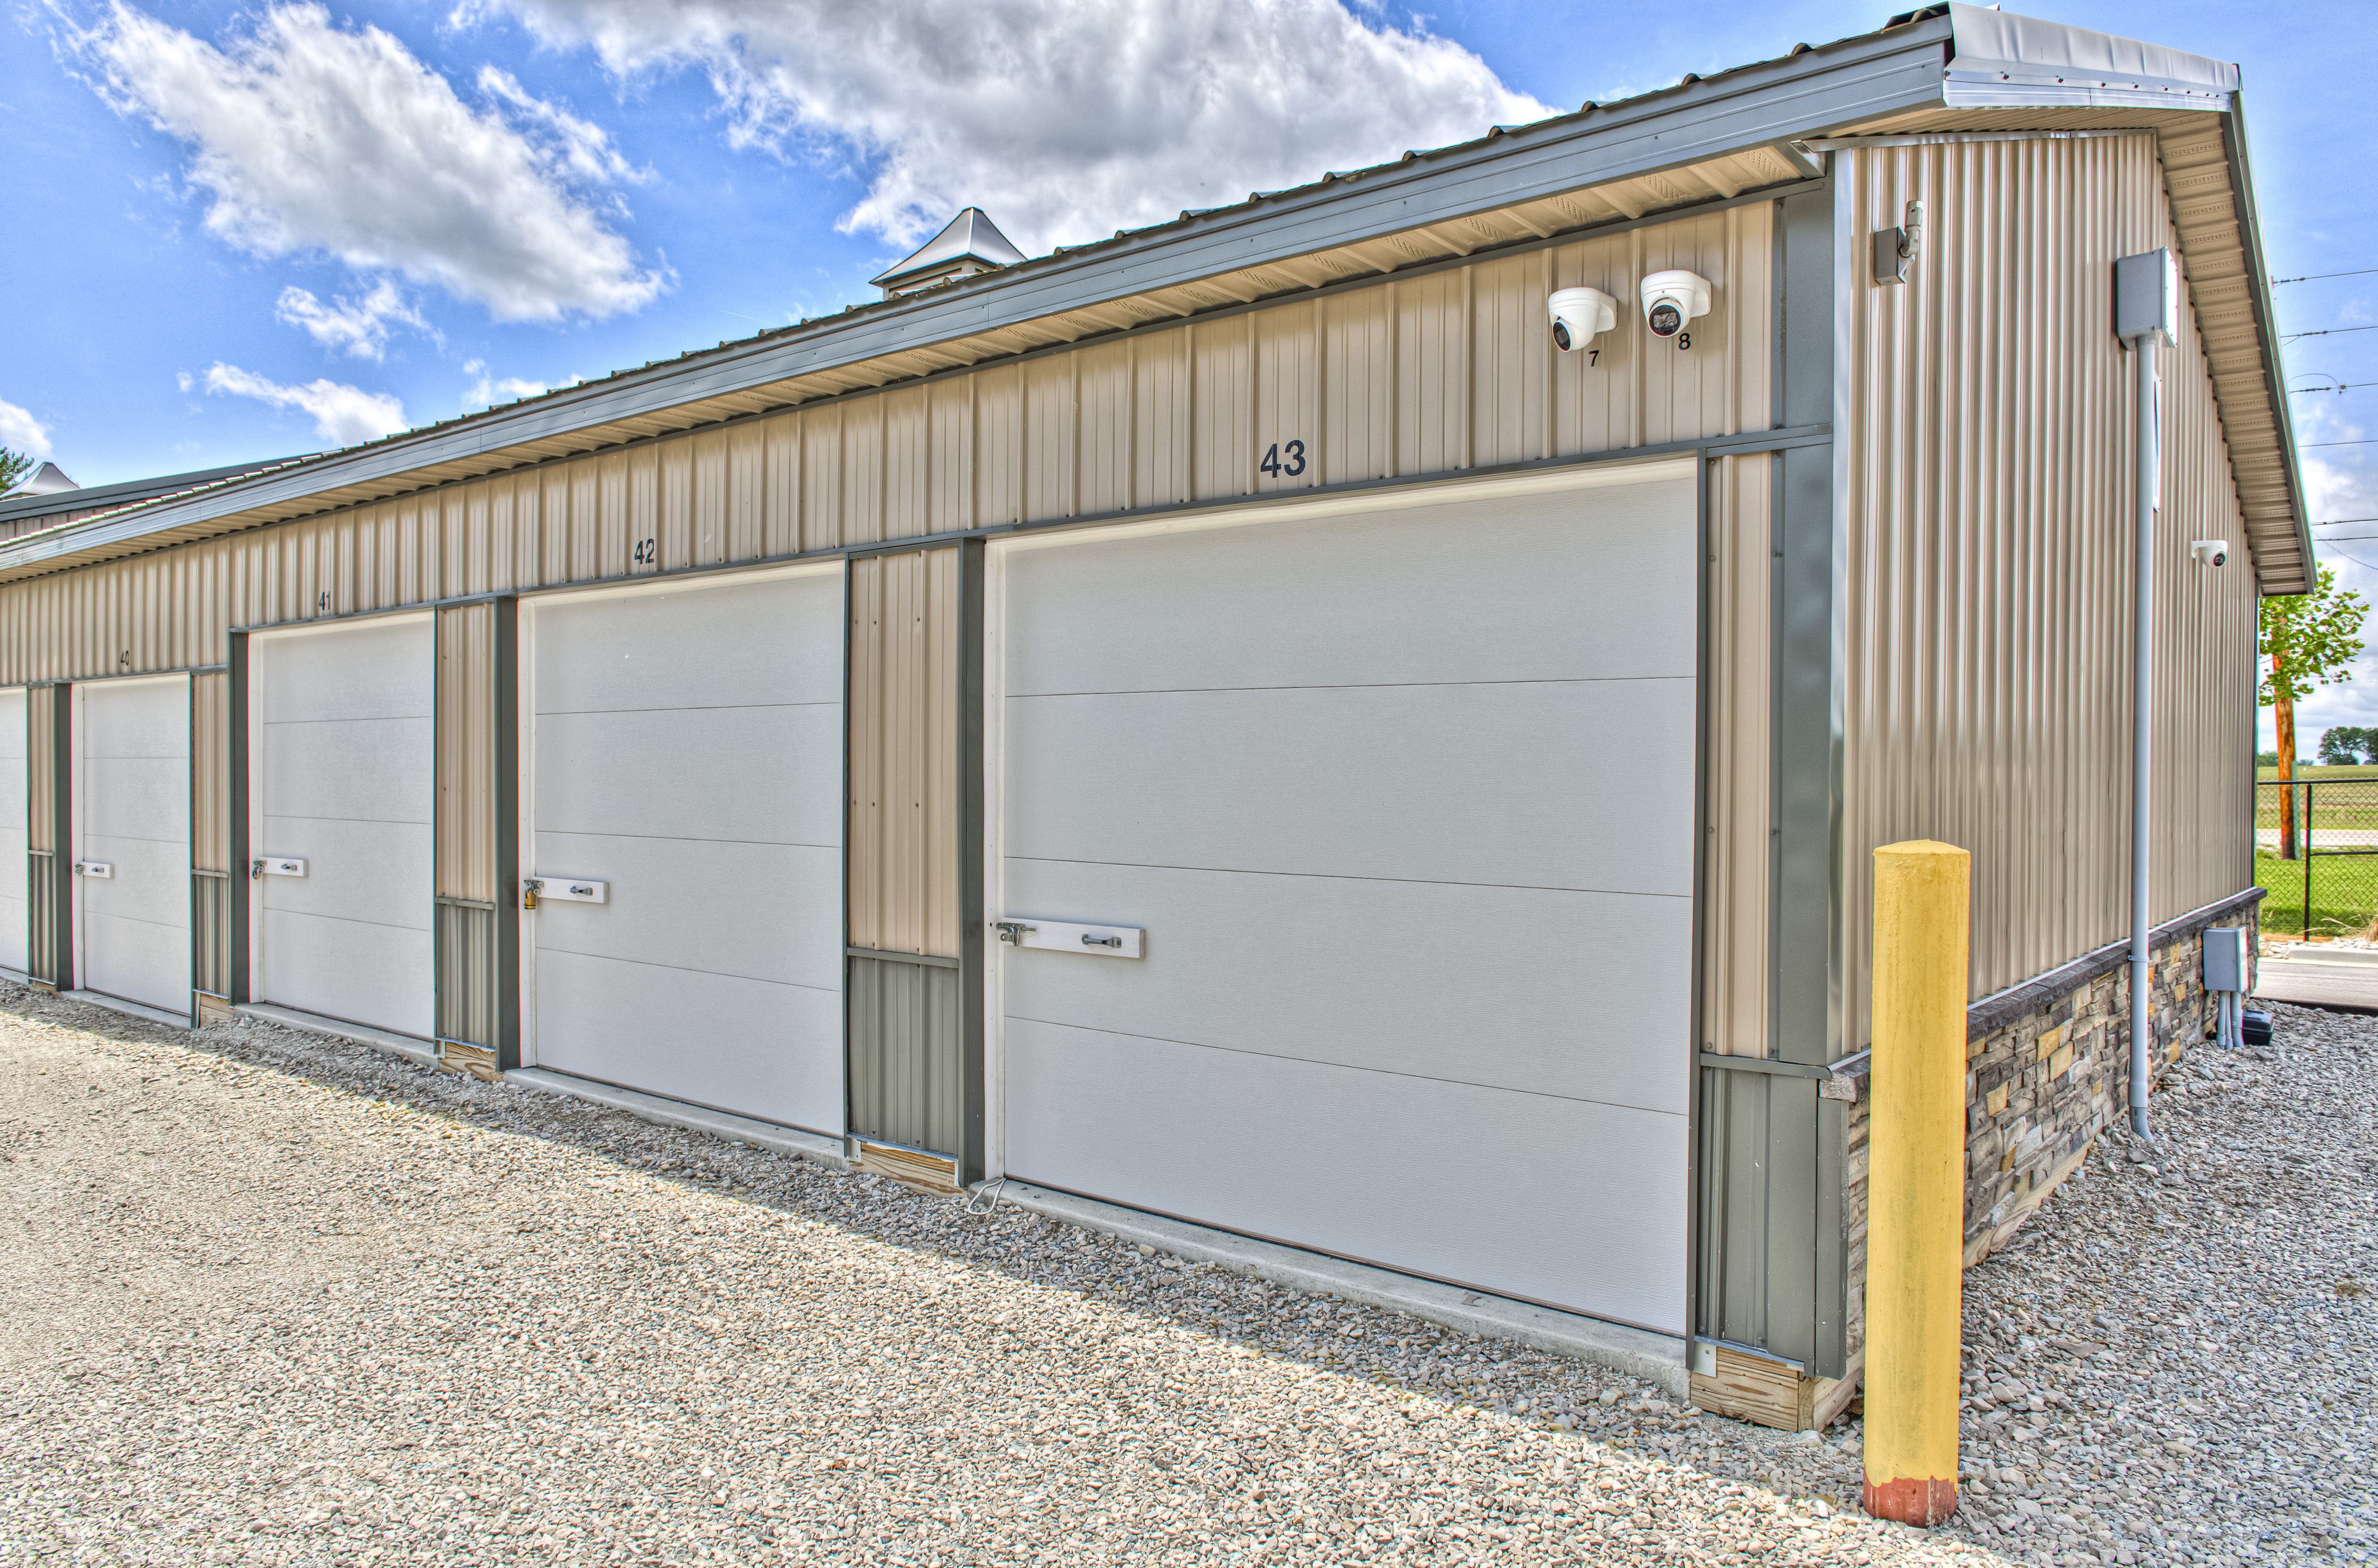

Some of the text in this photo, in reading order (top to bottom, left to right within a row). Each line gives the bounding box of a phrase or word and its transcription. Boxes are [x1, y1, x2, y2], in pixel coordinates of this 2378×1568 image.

[1678, 333, 1691, 350] 8
[1589, 349, 1599, 367] 7
[1260, 439, 1306, 479] 43
[634, 538, 654, 565] 42
[319, 591, 330, 611] 41
